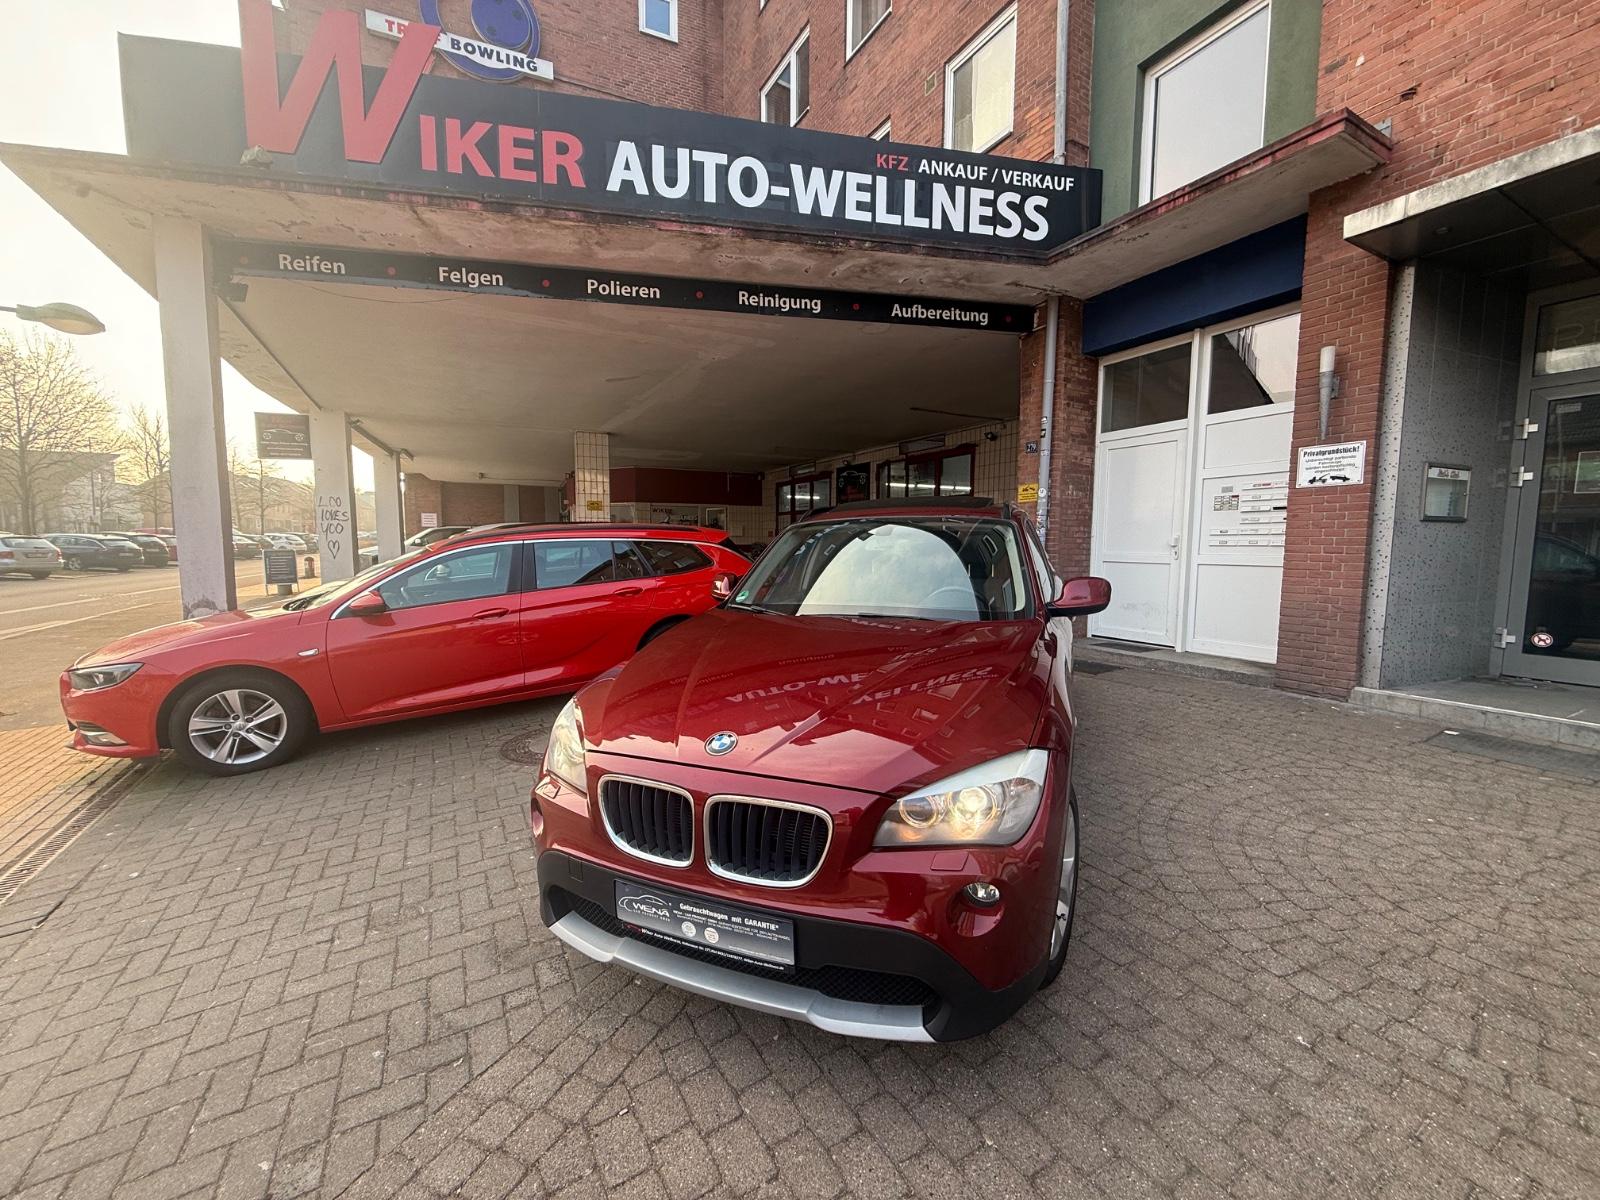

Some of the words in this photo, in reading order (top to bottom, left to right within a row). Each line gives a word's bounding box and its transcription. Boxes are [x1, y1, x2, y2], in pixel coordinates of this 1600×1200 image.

[450, 37, 538, 72] BOWLING
[237, 0, 587, 188] WIKER
[606, 140, 1049, 242] AUTO-WELLNESS
[876, 153, 909, 171] KFZ
[918, 158, 988, 181] ANKAUF
[1001, 169, 1075, 192] VERKAUF
[278, 253, 346, 275] Reifen
[438, 266, 504, 288] Felgen
[587, 279, 660, 299] Polieren
[738, 290, 822, 313] Reinigung
[891, 303, 988, 326] Aufbereitung
[679, 902, 729, 920] Gebrauchtwagen
[731, 916, 743, 924] mit
